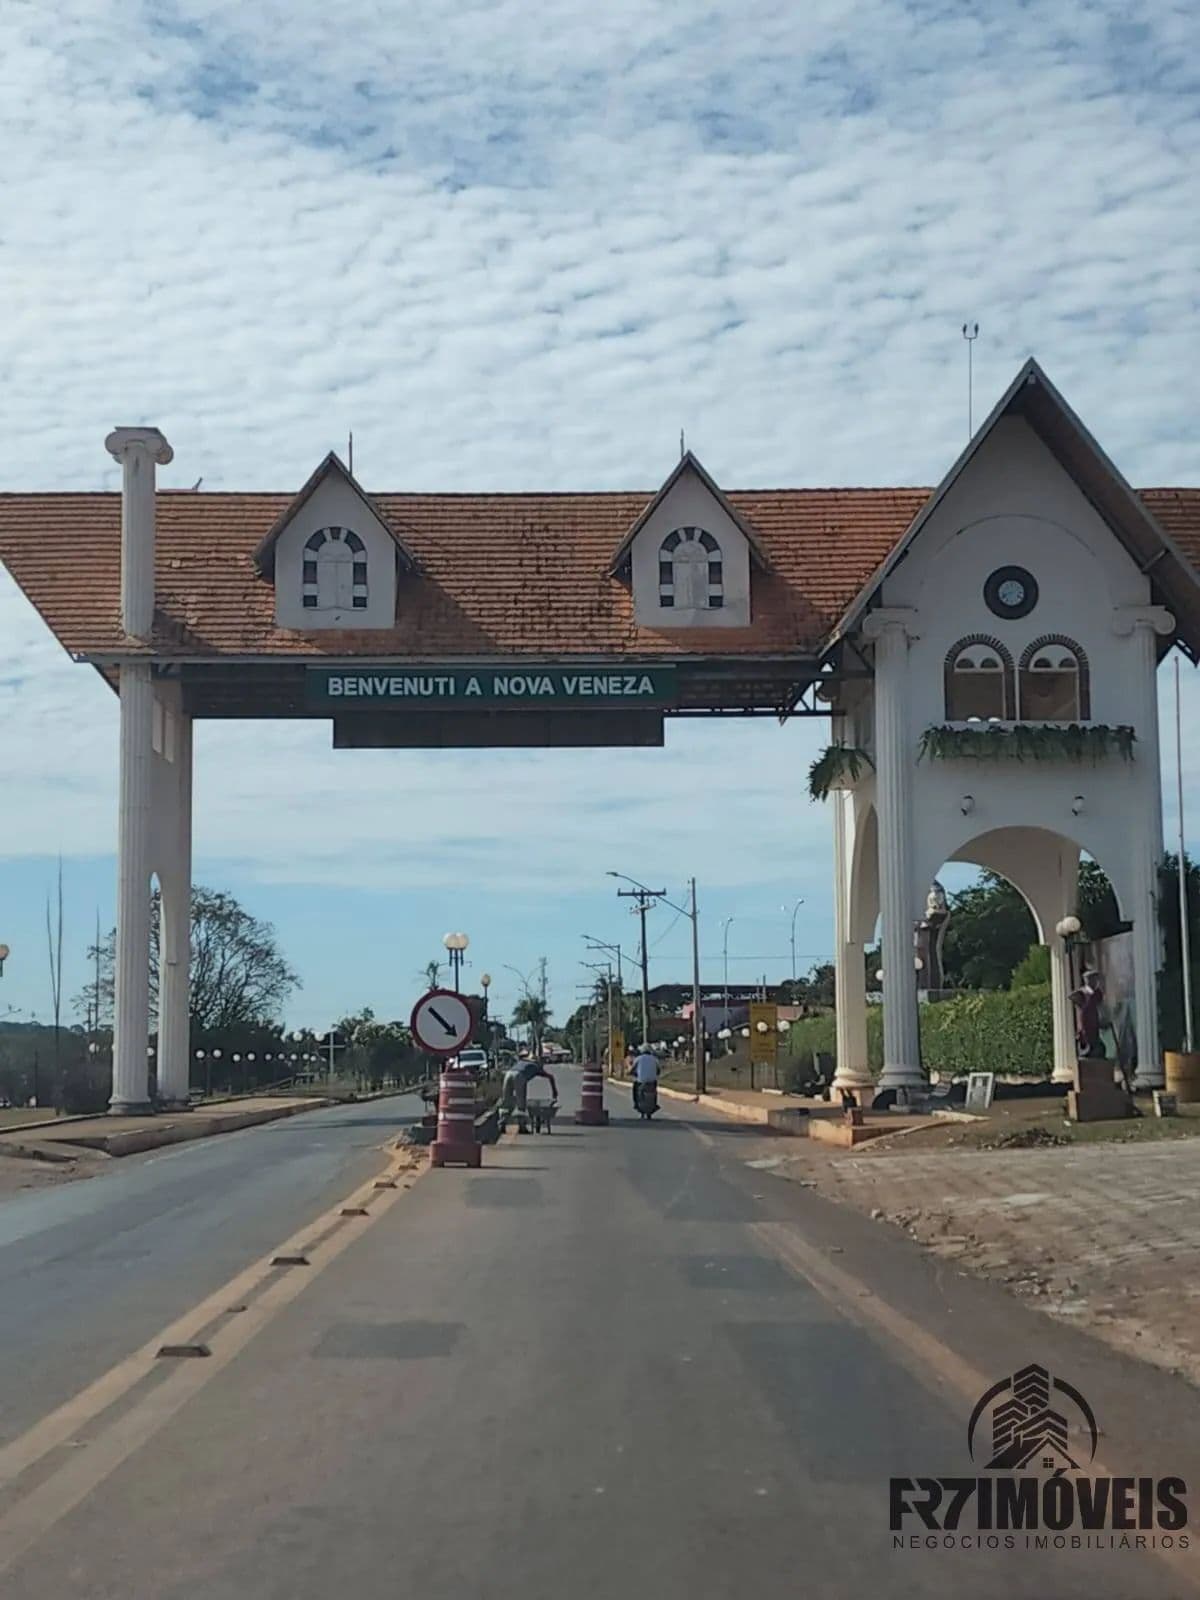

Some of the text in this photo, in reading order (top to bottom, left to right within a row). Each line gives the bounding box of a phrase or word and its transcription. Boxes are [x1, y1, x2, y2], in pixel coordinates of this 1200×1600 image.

[328, 676, 654, 696] BENVENUTI A NOVA VENEZA
